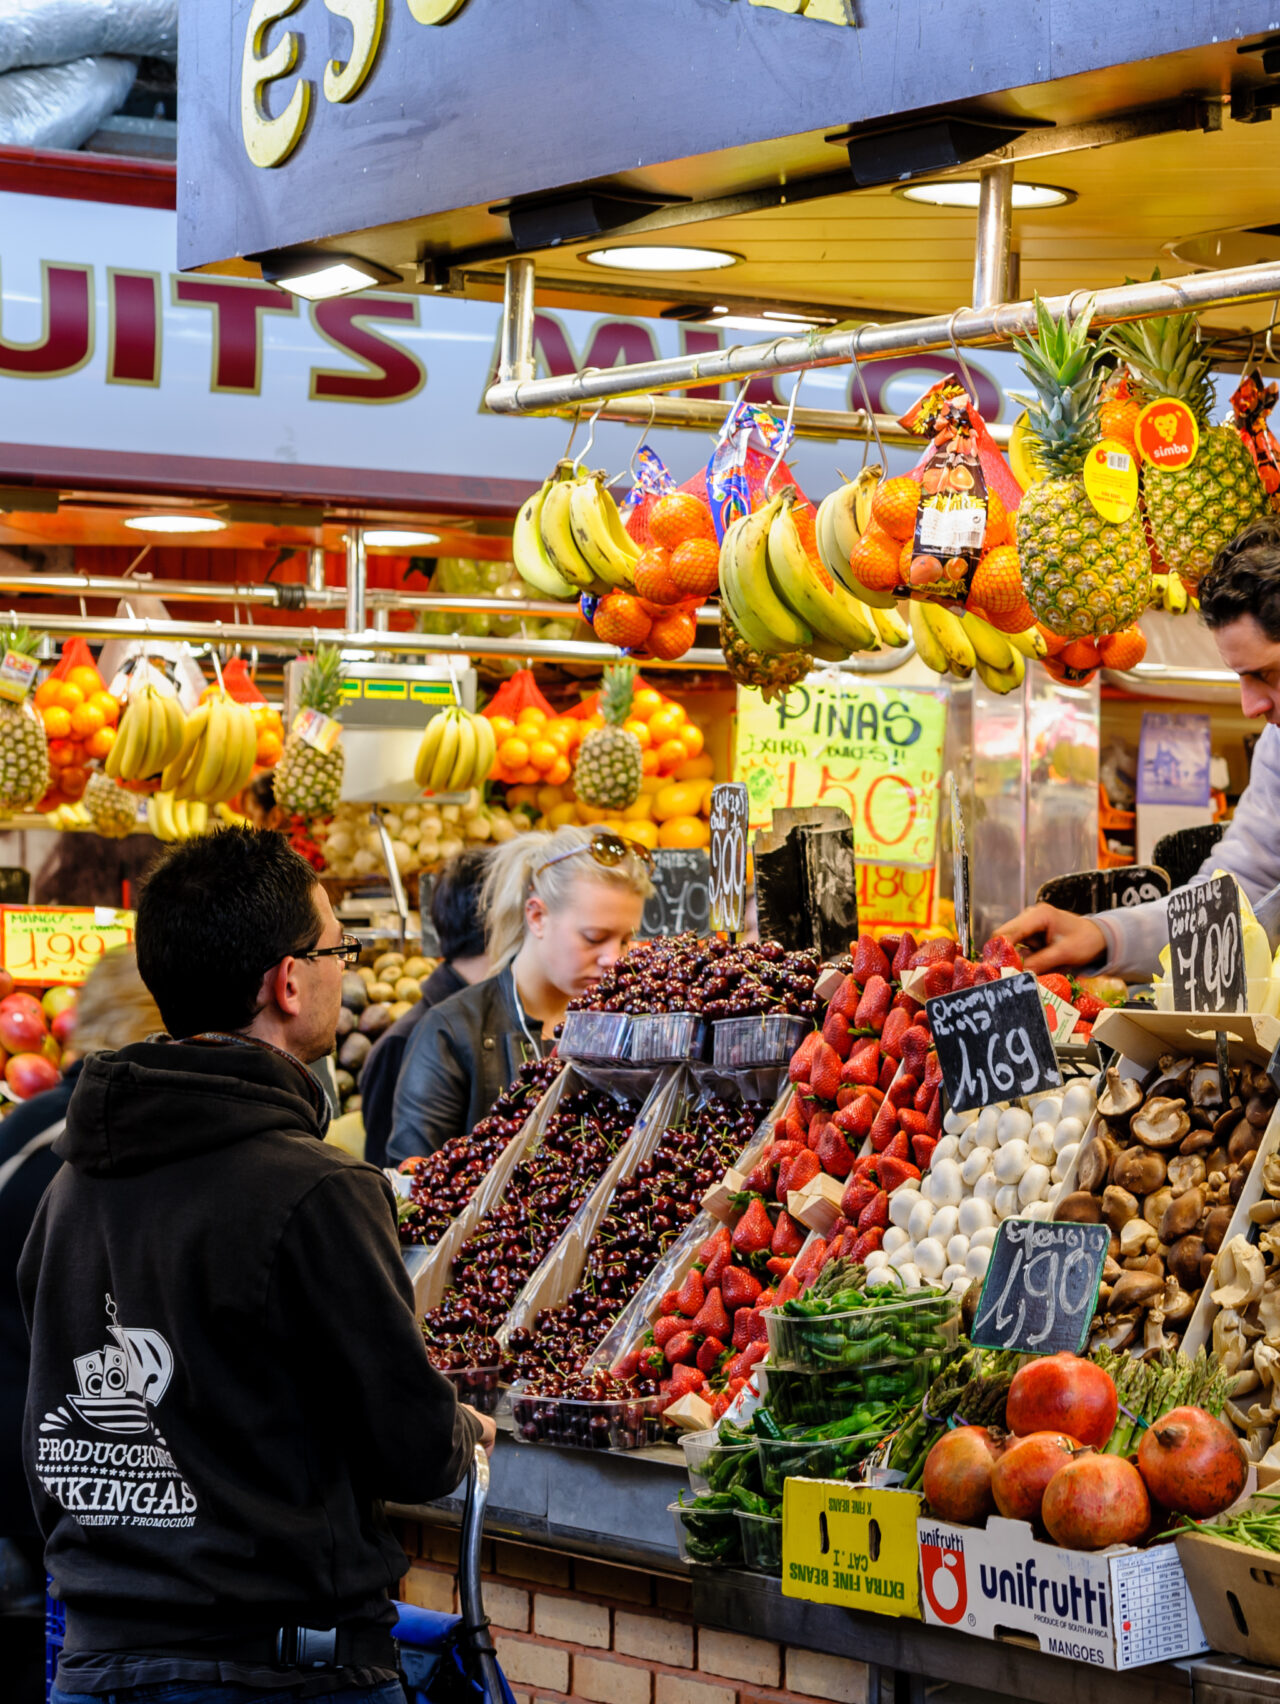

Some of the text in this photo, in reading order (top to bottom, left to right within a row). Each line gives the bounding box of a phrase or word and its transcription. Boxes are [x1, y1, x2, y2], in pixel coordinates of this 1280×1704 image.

[1153, 443, 1189, 458] simba
[776, 685, 922, 747] PIÑAS
[740, 733, 808, 758] EXTRA
[952, 1026, 1041, 1108] 1,69
[975, 1247, 1096, 1349] 1,90
[828, 1498, 872, 1516] X FINE BEANS
[121, 1515, 130, 1526] Y
[131, 1515, 197, 1528] PROMOCIÓN
[919, 1529, 964, 1553] unifrutti
[789, 1562, 905, 1600] EXTRA FINE BEANS
[979, 1558, 1108, 1628] unifrutti
[1033, 1613, 1109, 1639] PRODUCE OF SOUTH AFRICA
[1048, 1637, 1105, 1665] MANGOES
